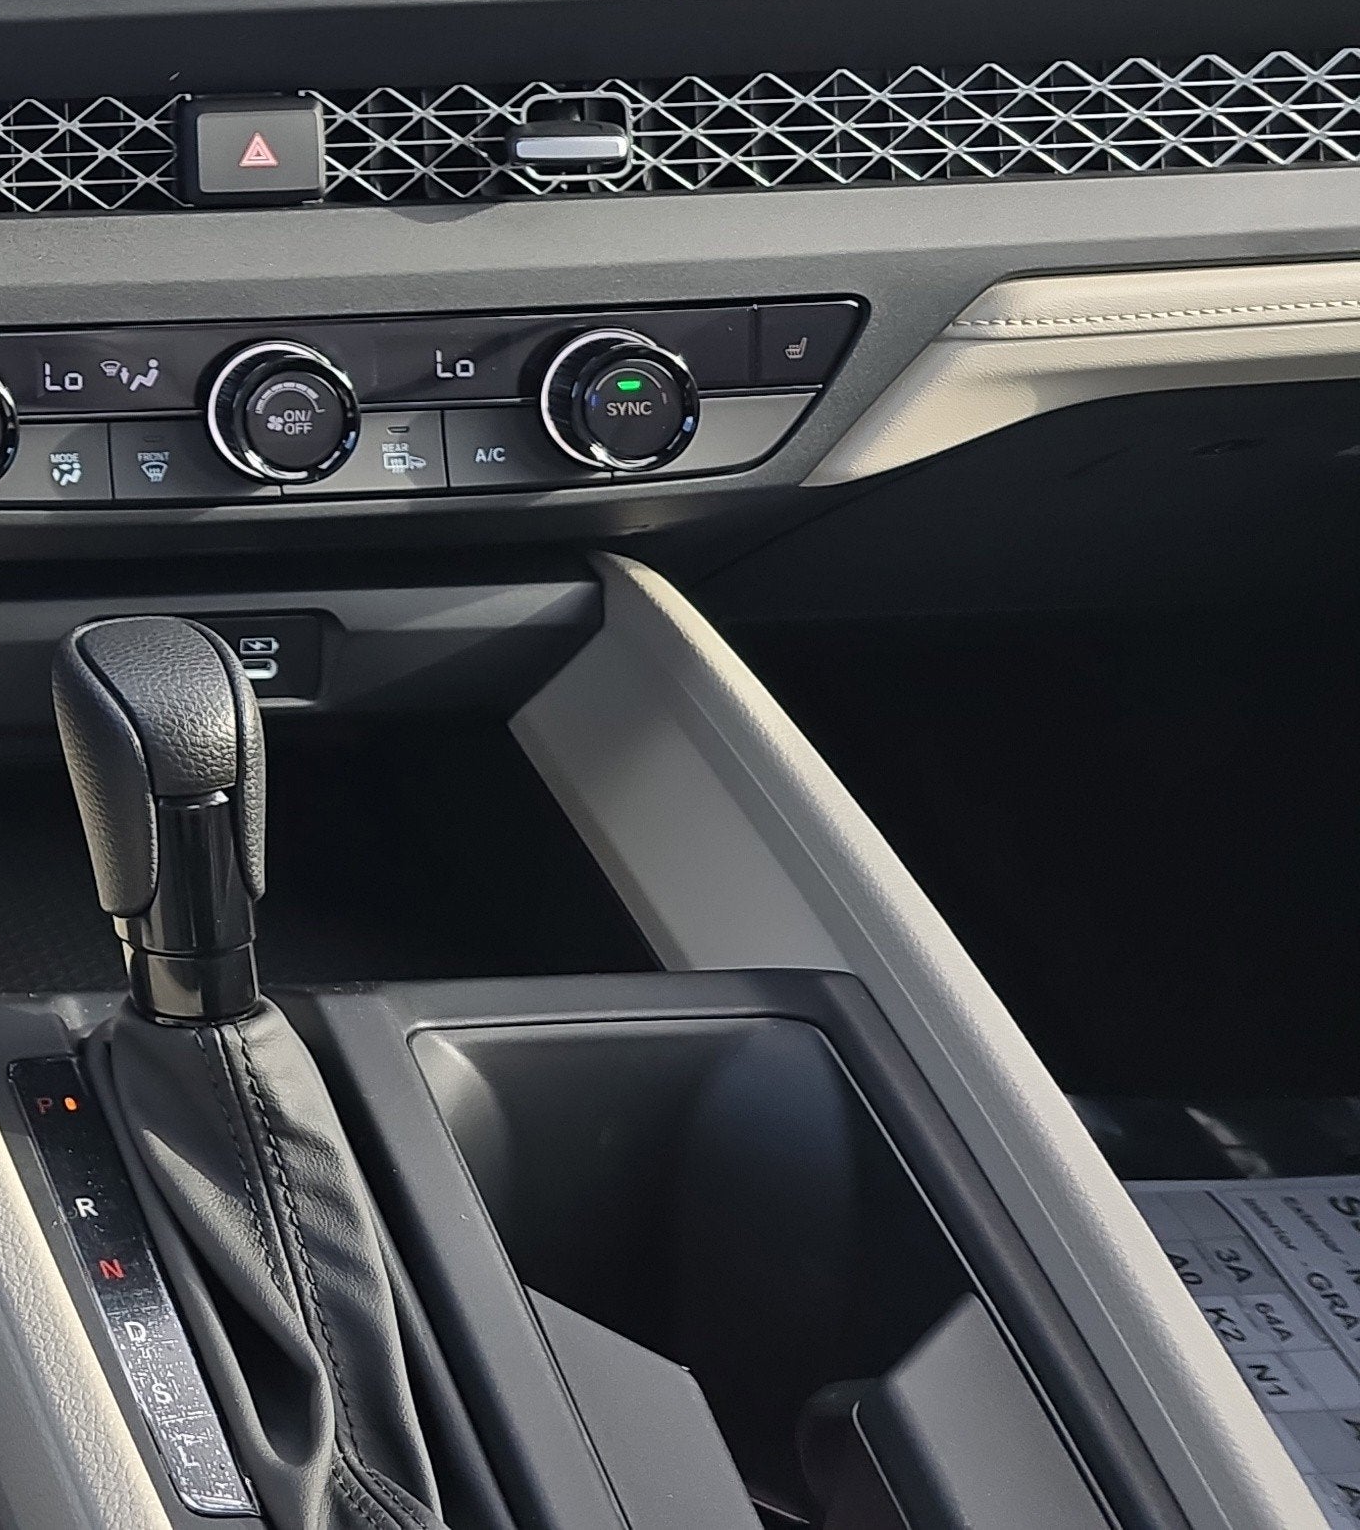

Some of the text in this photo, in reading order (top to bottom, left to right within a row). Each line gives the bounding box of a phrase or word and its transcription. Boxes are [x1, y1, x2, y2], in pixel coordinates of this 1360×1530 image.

[283, 409, 312, 423] ON/
[606, 401, 653, 417] SYNC
[284, 422, 313, 435] OFF
[382, 443, 409, 453] REAR
[475, 448, 506, 463] A/C
[49, 452, 80, 463] MODE
[137, 451, 170, 462] FRONT
[75, 1197, 99, 1218] R
[99, 1259, 125, 1280] N
[1215, 1248, 1253, 1283] 3A
[124, 1321, 147, 1342] D
[152, 1382, 174, 1404] S
